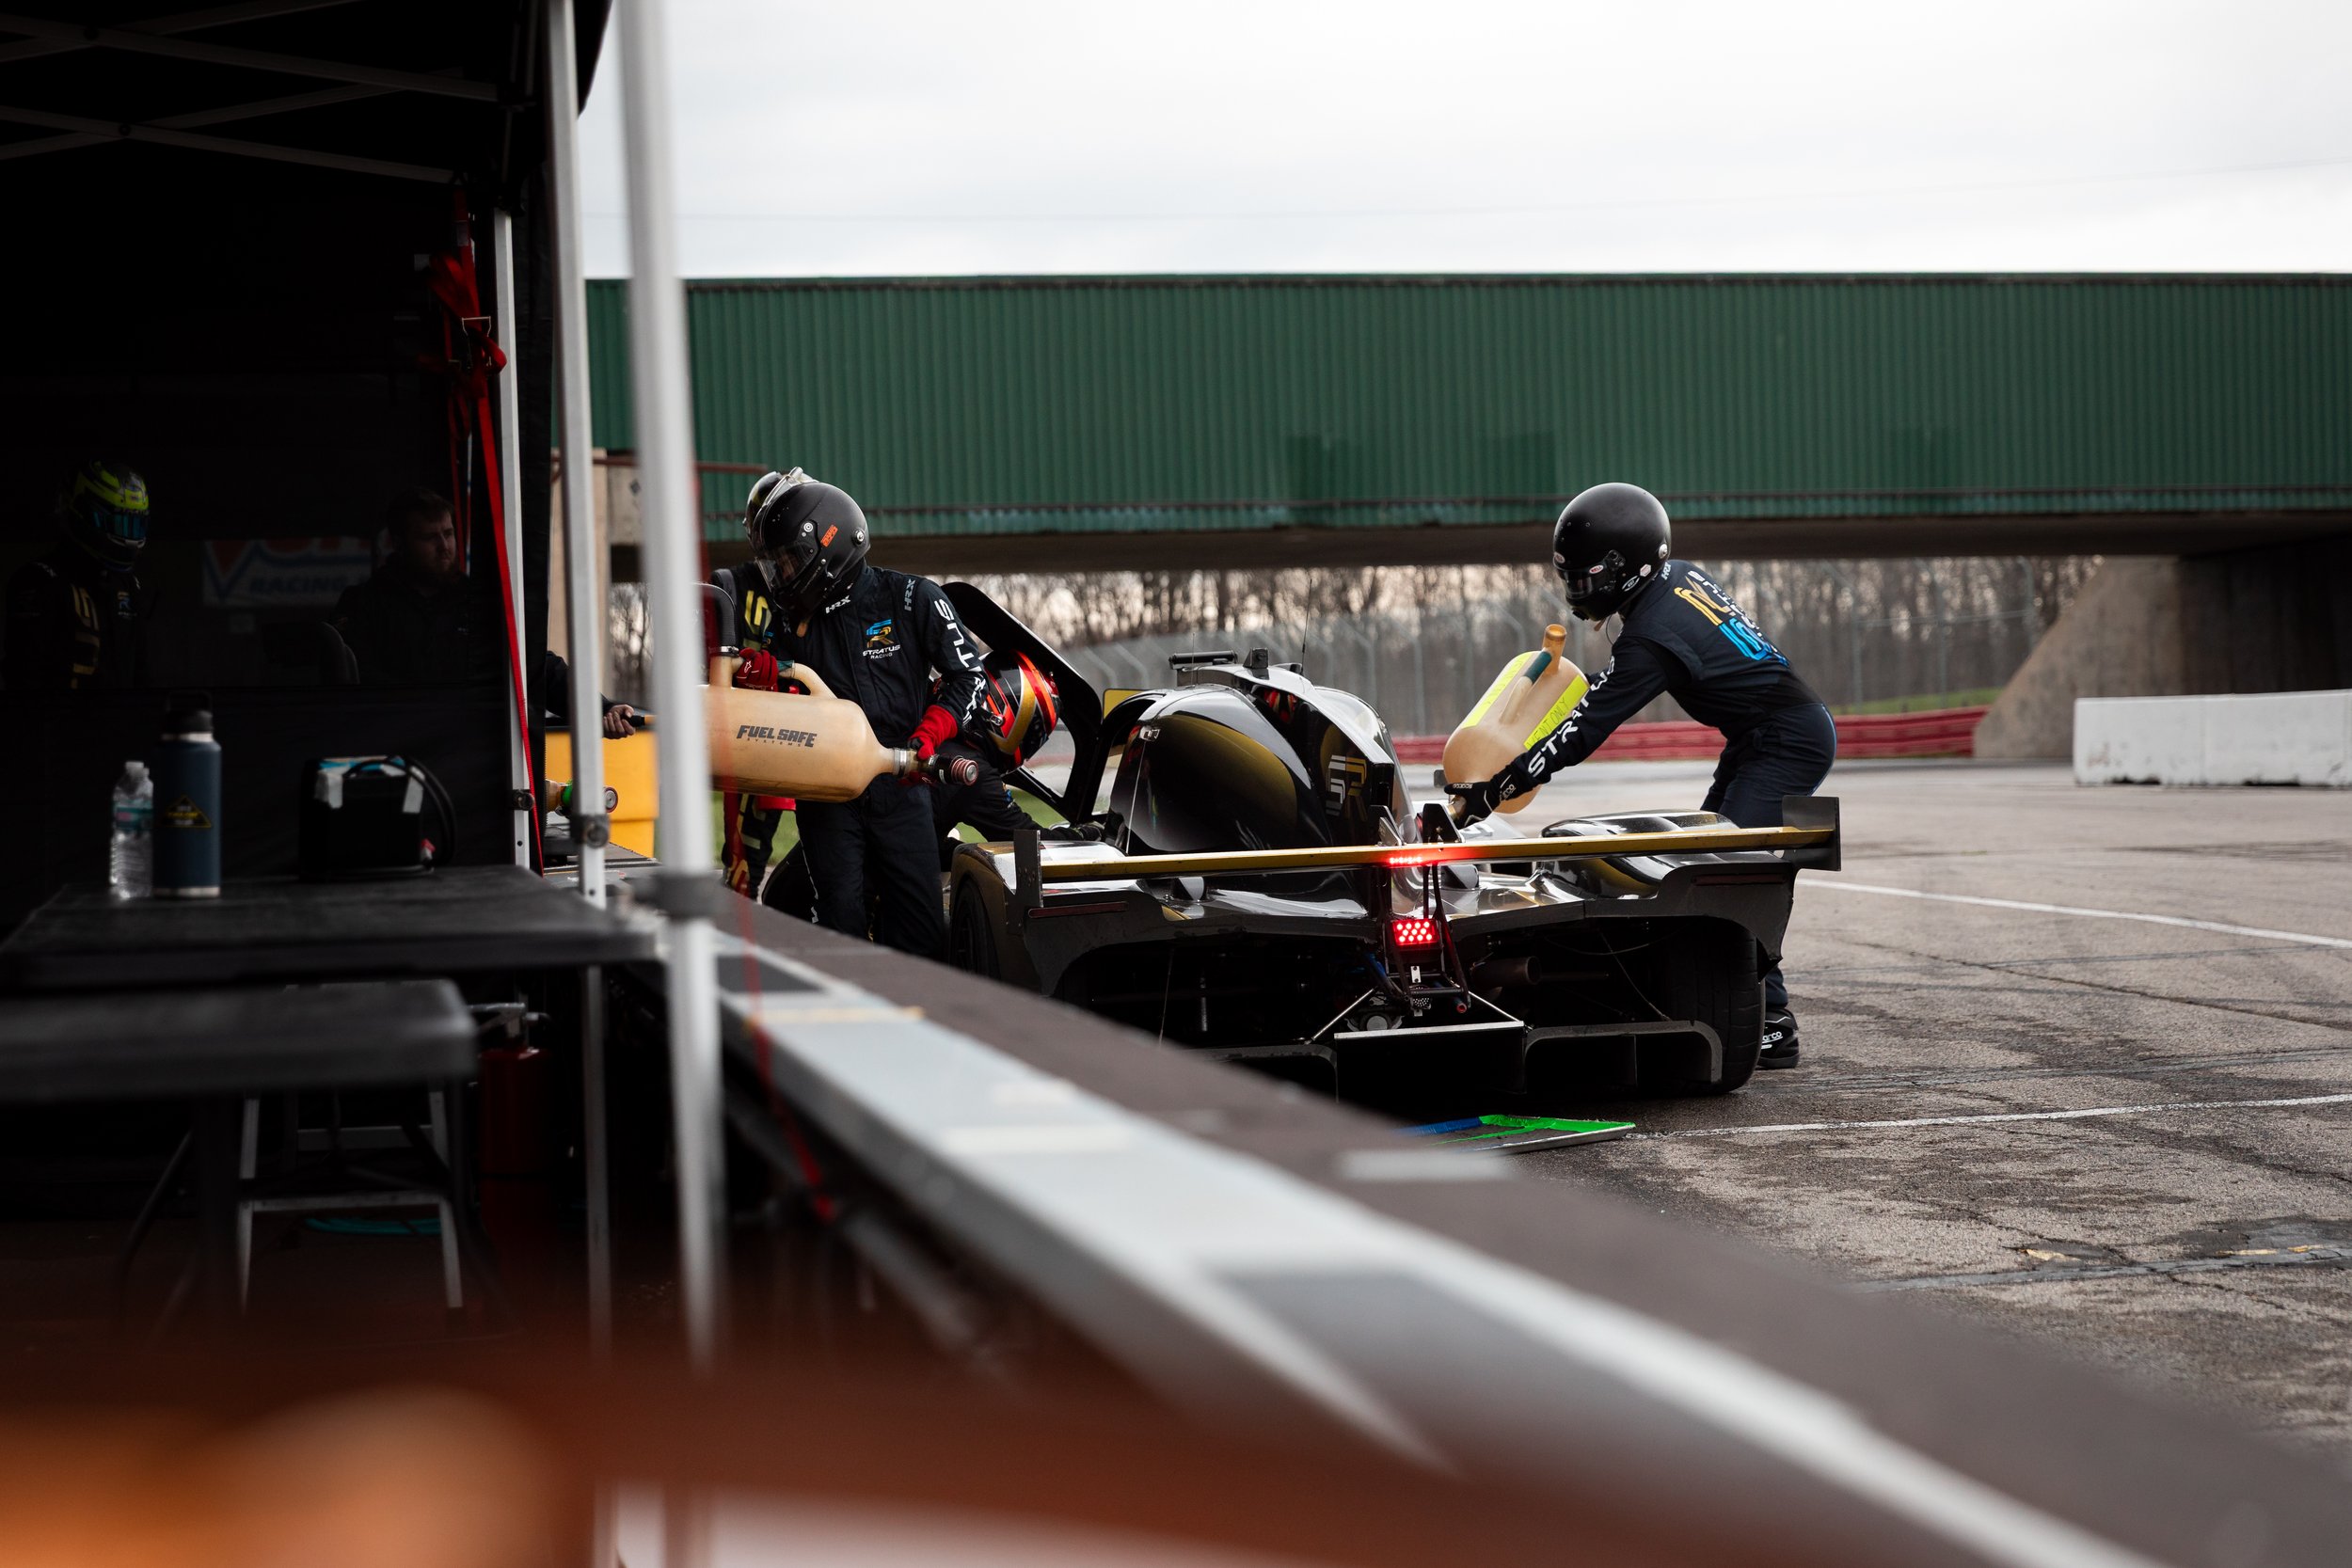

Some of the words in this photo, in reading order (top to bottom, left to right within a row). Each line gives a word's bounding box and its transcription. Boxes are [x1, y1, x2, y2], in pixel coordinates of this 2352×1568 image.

[904, 578, 916, 611] HRX
[825, 594, 851, 614] HRX
[862, 644, 901, 657] STRATUS
[736, 724, 775, 740] FUEL
[776, 728, 818, 748] SAFE
[747, 737, 802, 748] SYSTEMS
[1762, 1031, 1783, 1042] arco
